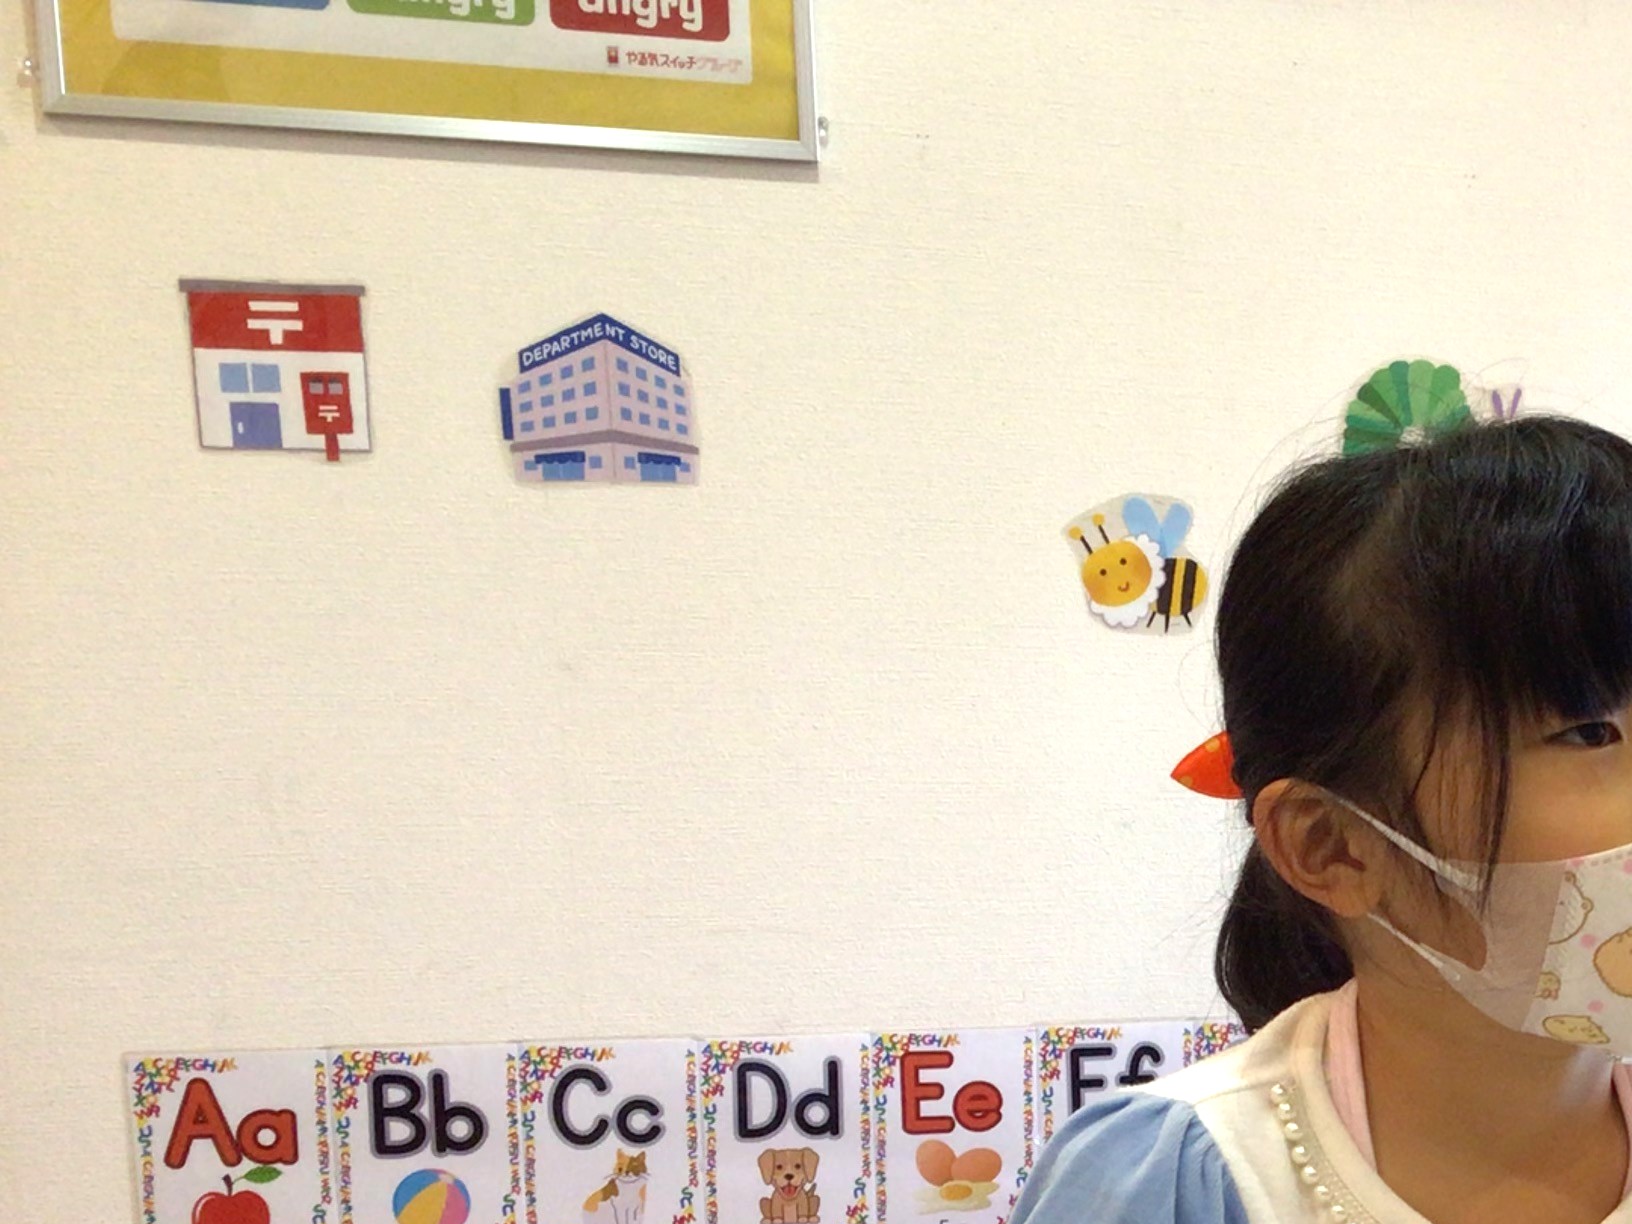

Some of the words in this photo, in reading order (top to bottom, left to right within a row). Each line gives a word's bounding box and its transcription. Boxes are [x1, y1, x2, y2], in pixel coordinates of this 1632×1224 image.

[521, 322, 627, 367] DEPARTMENT
[629, 335, 678, 371] STORE
[163, 1077, 299, 1169] Aa
[367, 1069, 488, 1159] Bb
[549, 1064, 665, 1148] Cc
[733, 1055, 844, 1143] Dd
[900, 1050, 1003, 1135] Ee
